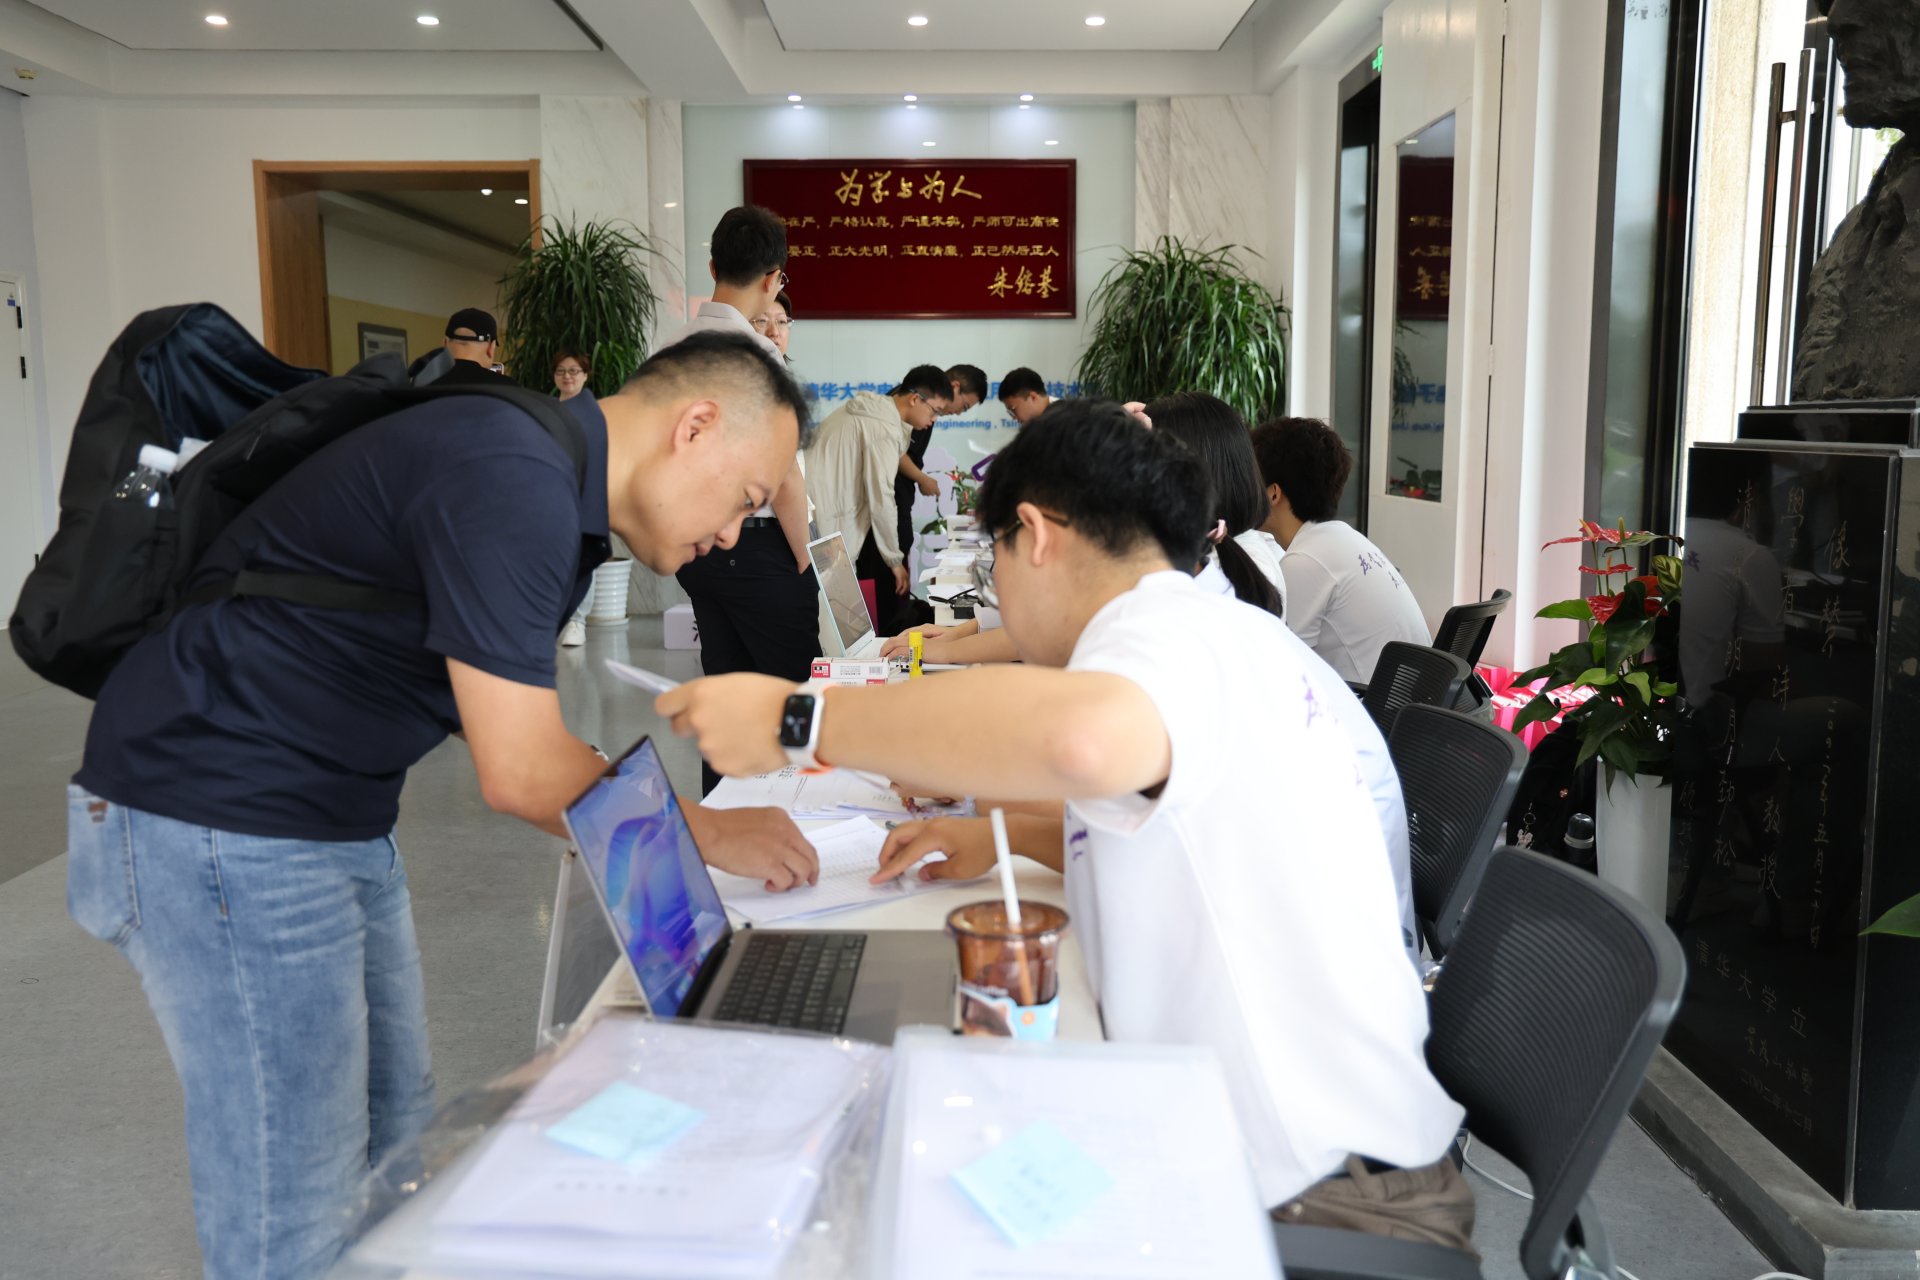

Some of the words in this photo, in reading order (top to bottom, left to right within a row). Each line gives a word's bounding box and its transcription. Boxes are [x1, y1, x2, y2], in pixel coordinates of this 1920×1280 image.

[835, 168, 982, 206] 为学与为人
